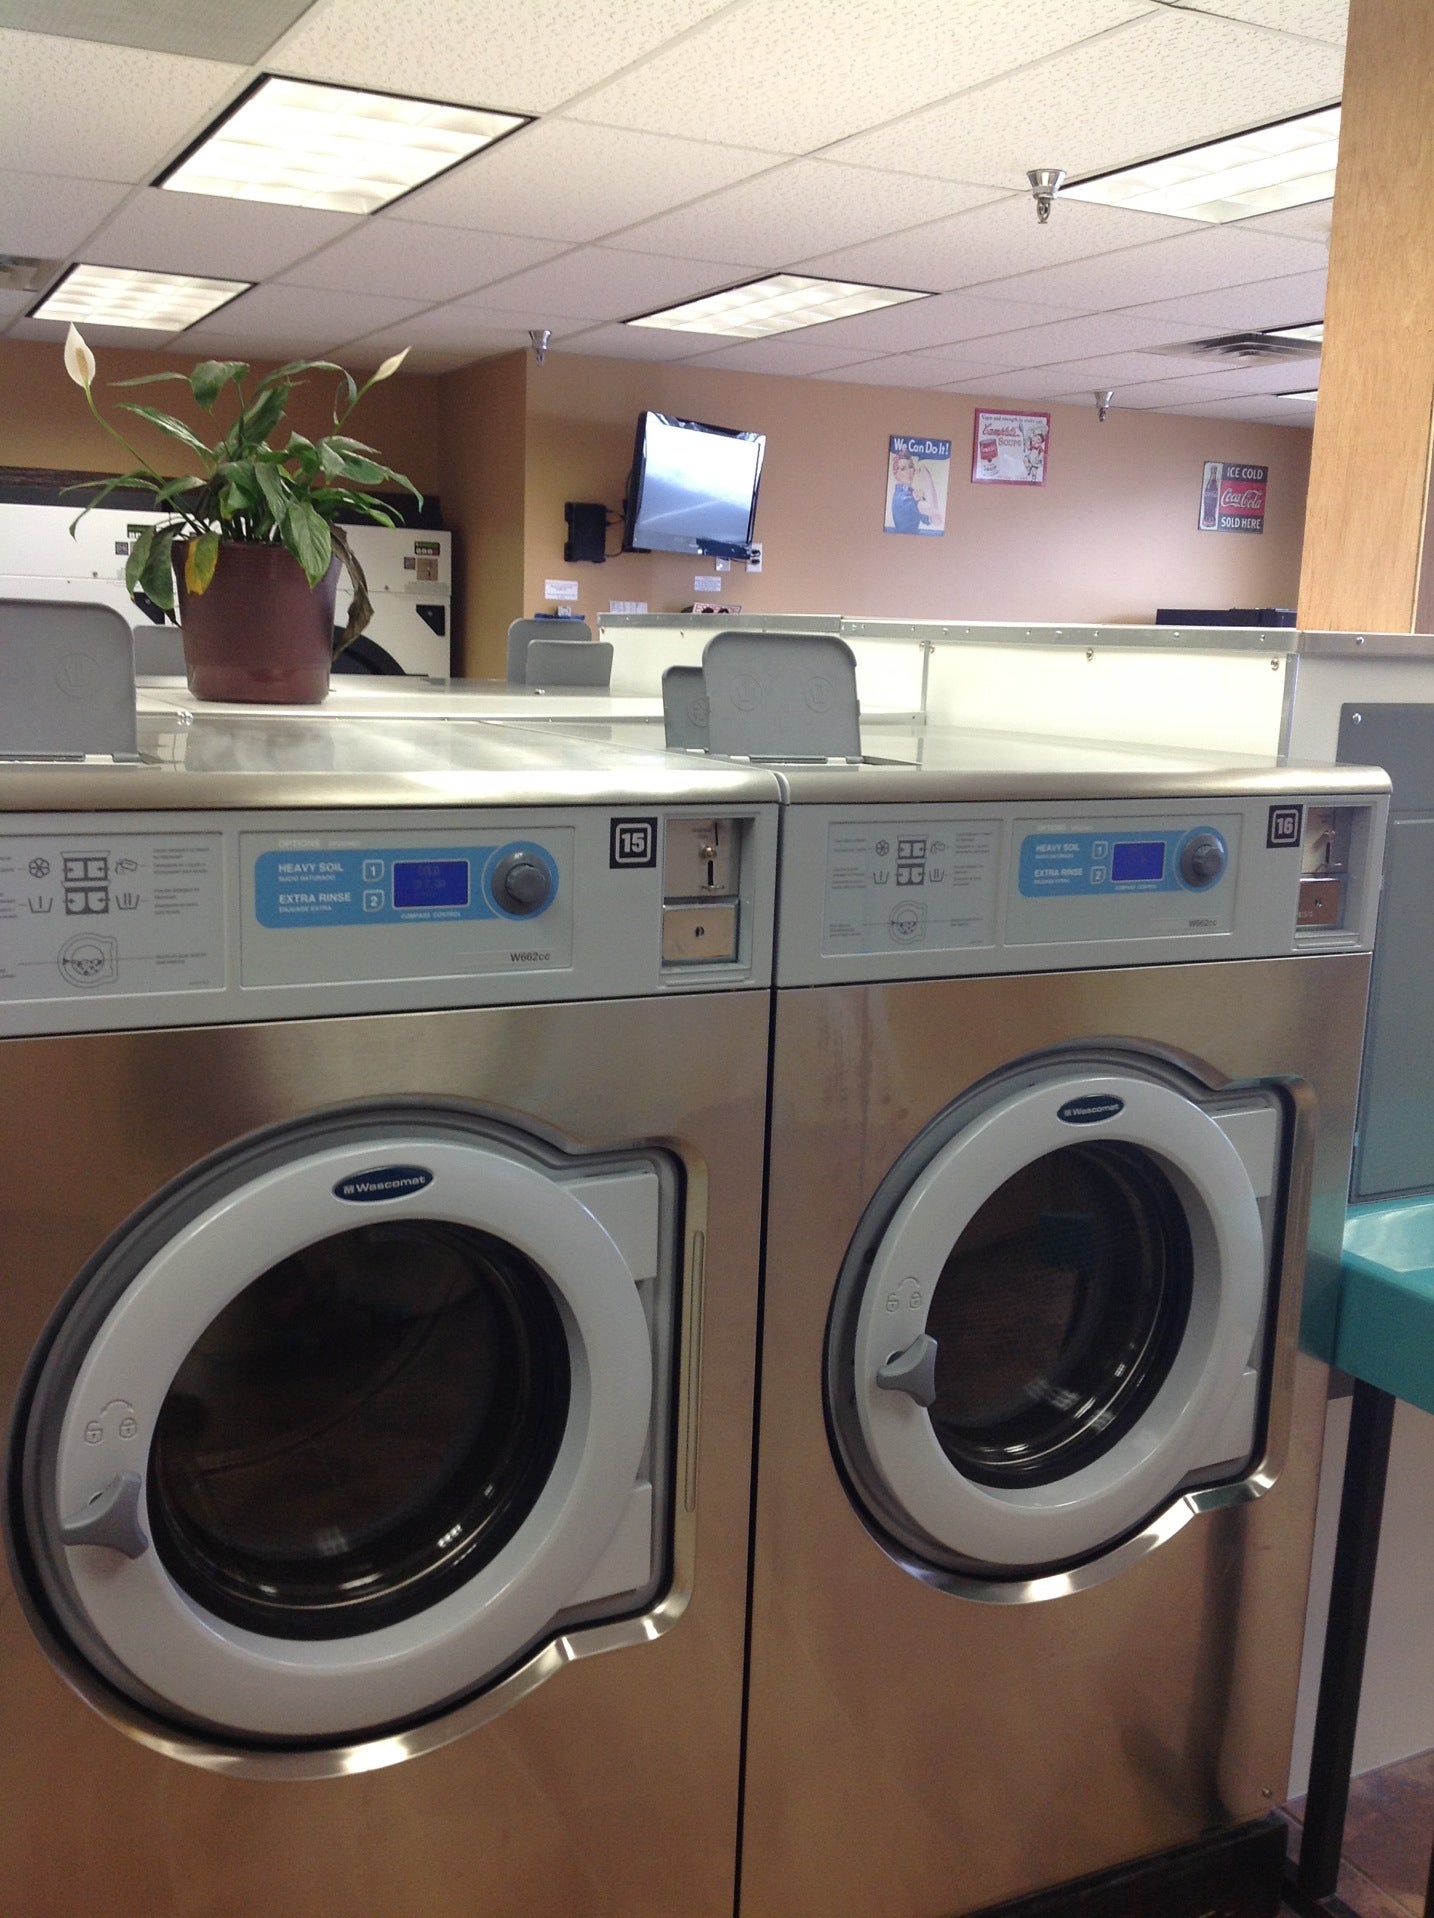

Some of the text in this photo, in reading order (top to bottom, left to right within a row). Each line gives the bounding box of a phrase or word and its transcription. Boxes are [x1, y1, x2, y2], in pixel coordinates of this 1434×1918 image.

[894, 438, 949, 455] We Can Do It!
[1226, 466, 1263, 479] ICE COLD
[1221, 517, 1261, 530] SOLD HERE
[1276, 817, 1294, 835] 16
[622, 832, 645, 853] 15
[1035, 843, 1080, 853] HEAVY SOIL
[278, 862, 344, 874] HEAVY SOIL
[370, 865, 376, 877] 1
[1034, 868, 1083, 877] EXTRA RINSE
[1095, 871, 1101, 880] 2
[279, 892, 352, 904] EXTRA RINSE
[370, 896, 378, 907] 2
[510, 953, 551, 962] W662cc
[1072, 1104, 1119, 1116] Wascomat
[356, 1175, 426, 1192] Wascomat
